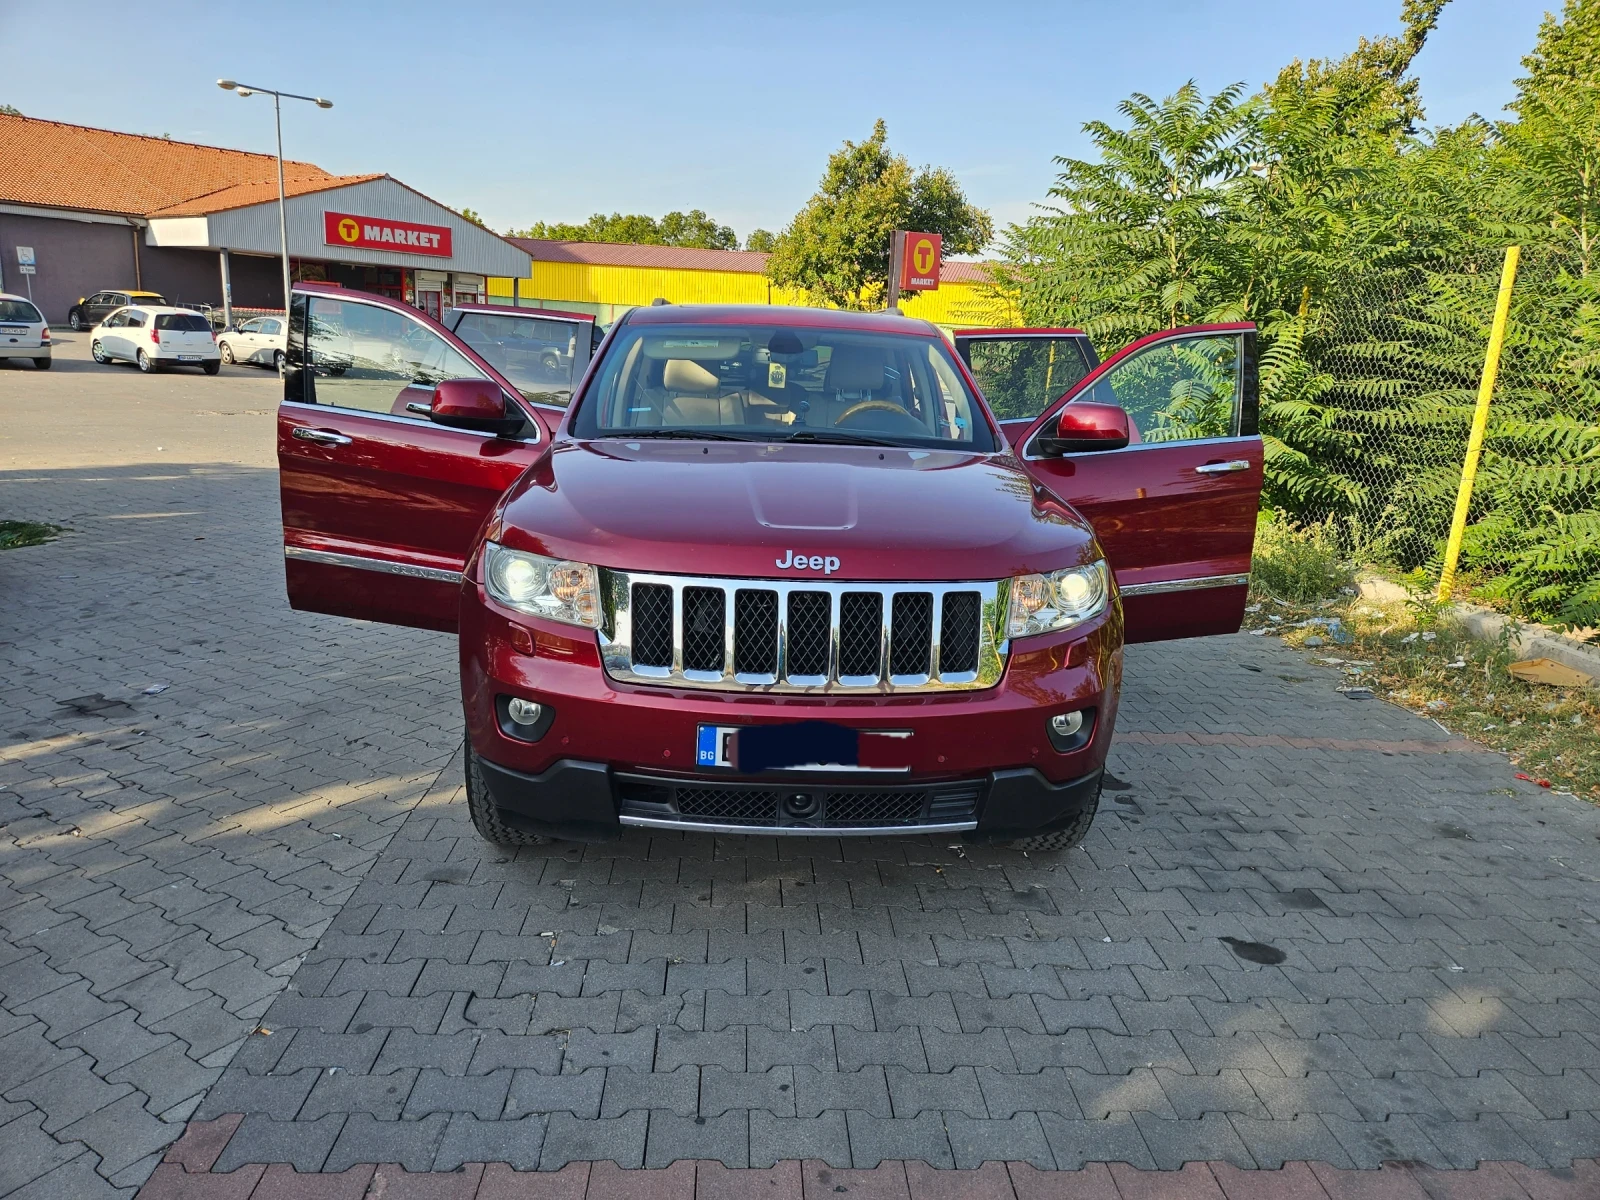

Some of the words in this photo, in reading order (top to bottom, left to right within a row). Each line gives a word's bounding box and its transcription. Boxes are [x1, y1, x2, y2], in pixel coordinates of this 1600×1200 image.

[342, 223, 356, 239] T
[364, 225, 441, 248] MARKET
[917, 246, 931, 269] T
[910, 277, 935, 286] MARKET
[391, 564, 437, 579] GRAND
[775, 549, 841, 575] Jeep
[700, 750, 714, 761] BG
